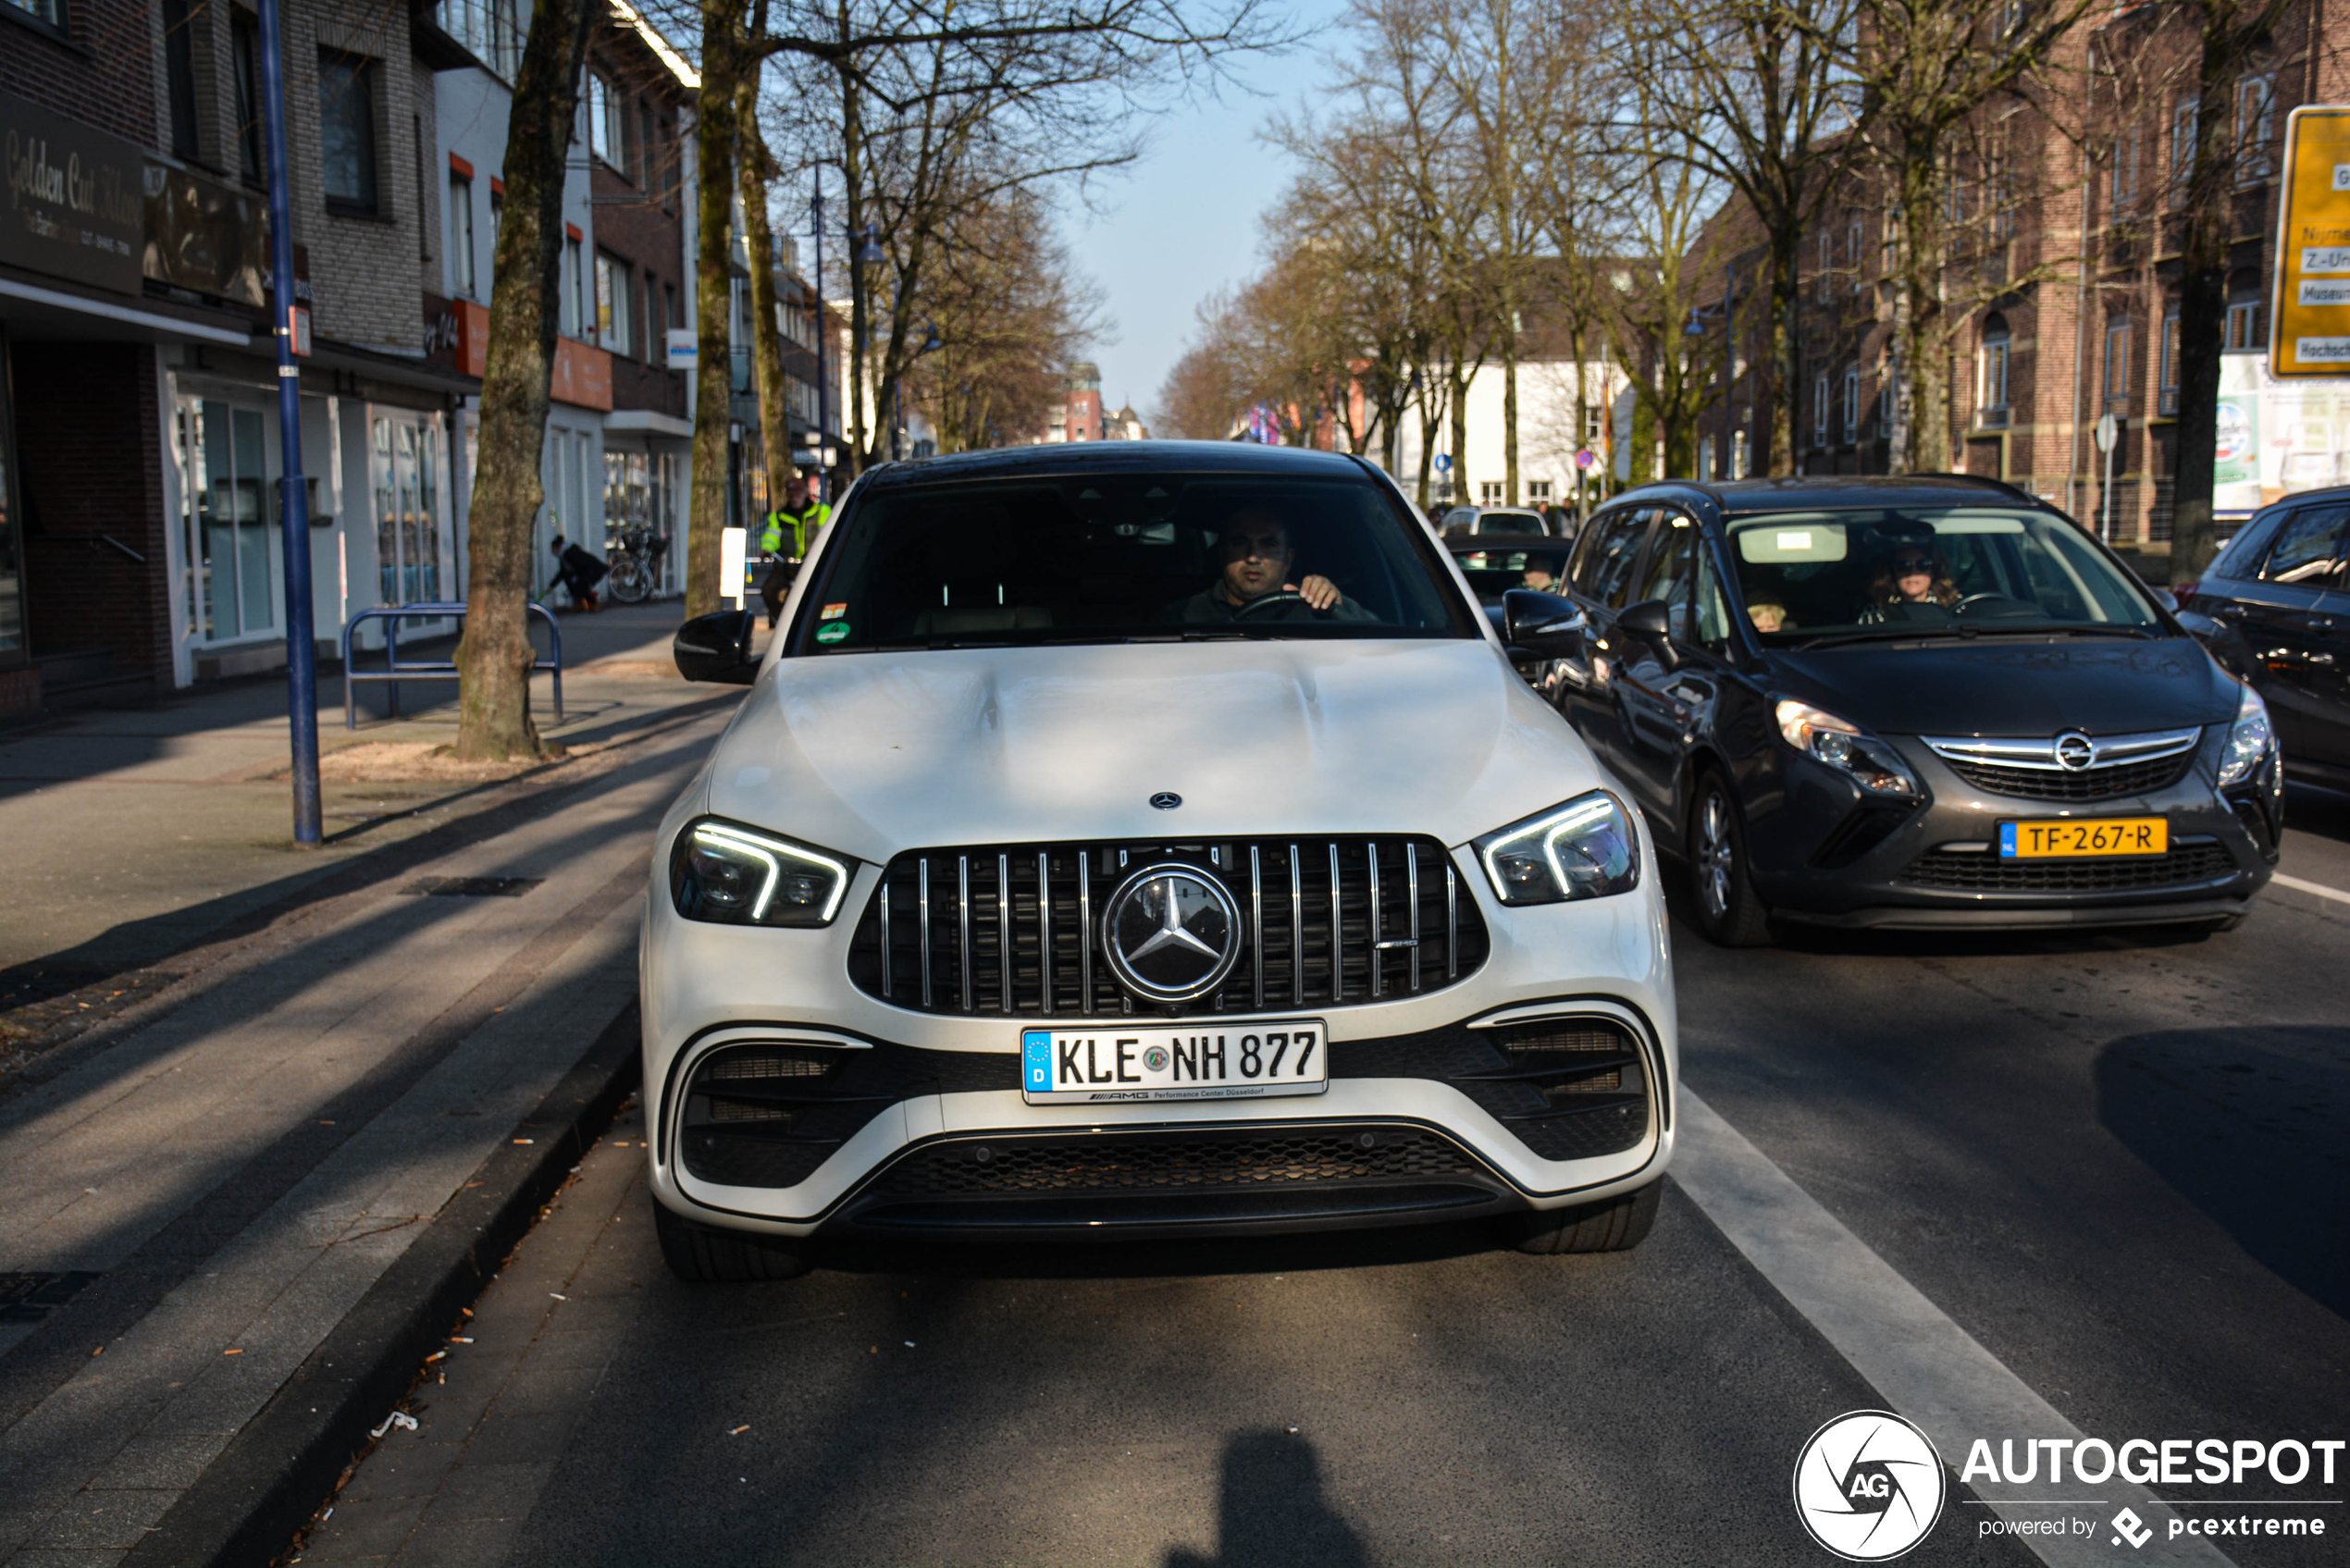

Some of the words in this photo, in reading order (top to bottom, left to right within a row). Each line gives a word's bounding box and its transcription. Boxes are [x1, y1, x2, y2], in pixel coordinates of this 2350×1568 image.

[6, 129, 64, 209] Golden
[68, 151, 95, 215] Cut
[2338, 170, 2350, 186] G
[2302, 227, 2350, 243] Nijme
[2307, 253, 2350, 268] Z.-Un
[2029, 825, 2152, 851] TF-267-R
[1058, 1038, 1142, 1084] KLE
[1172, 1035, 1226, 1081] NH
[1240, 1031, 1317, 1079] 877
[1033, 1068, 1045, 1083] D
[1154, 1091, 1199, 1099] Performance
[1226, 1087, 1265, 1096] Düsseldorf
